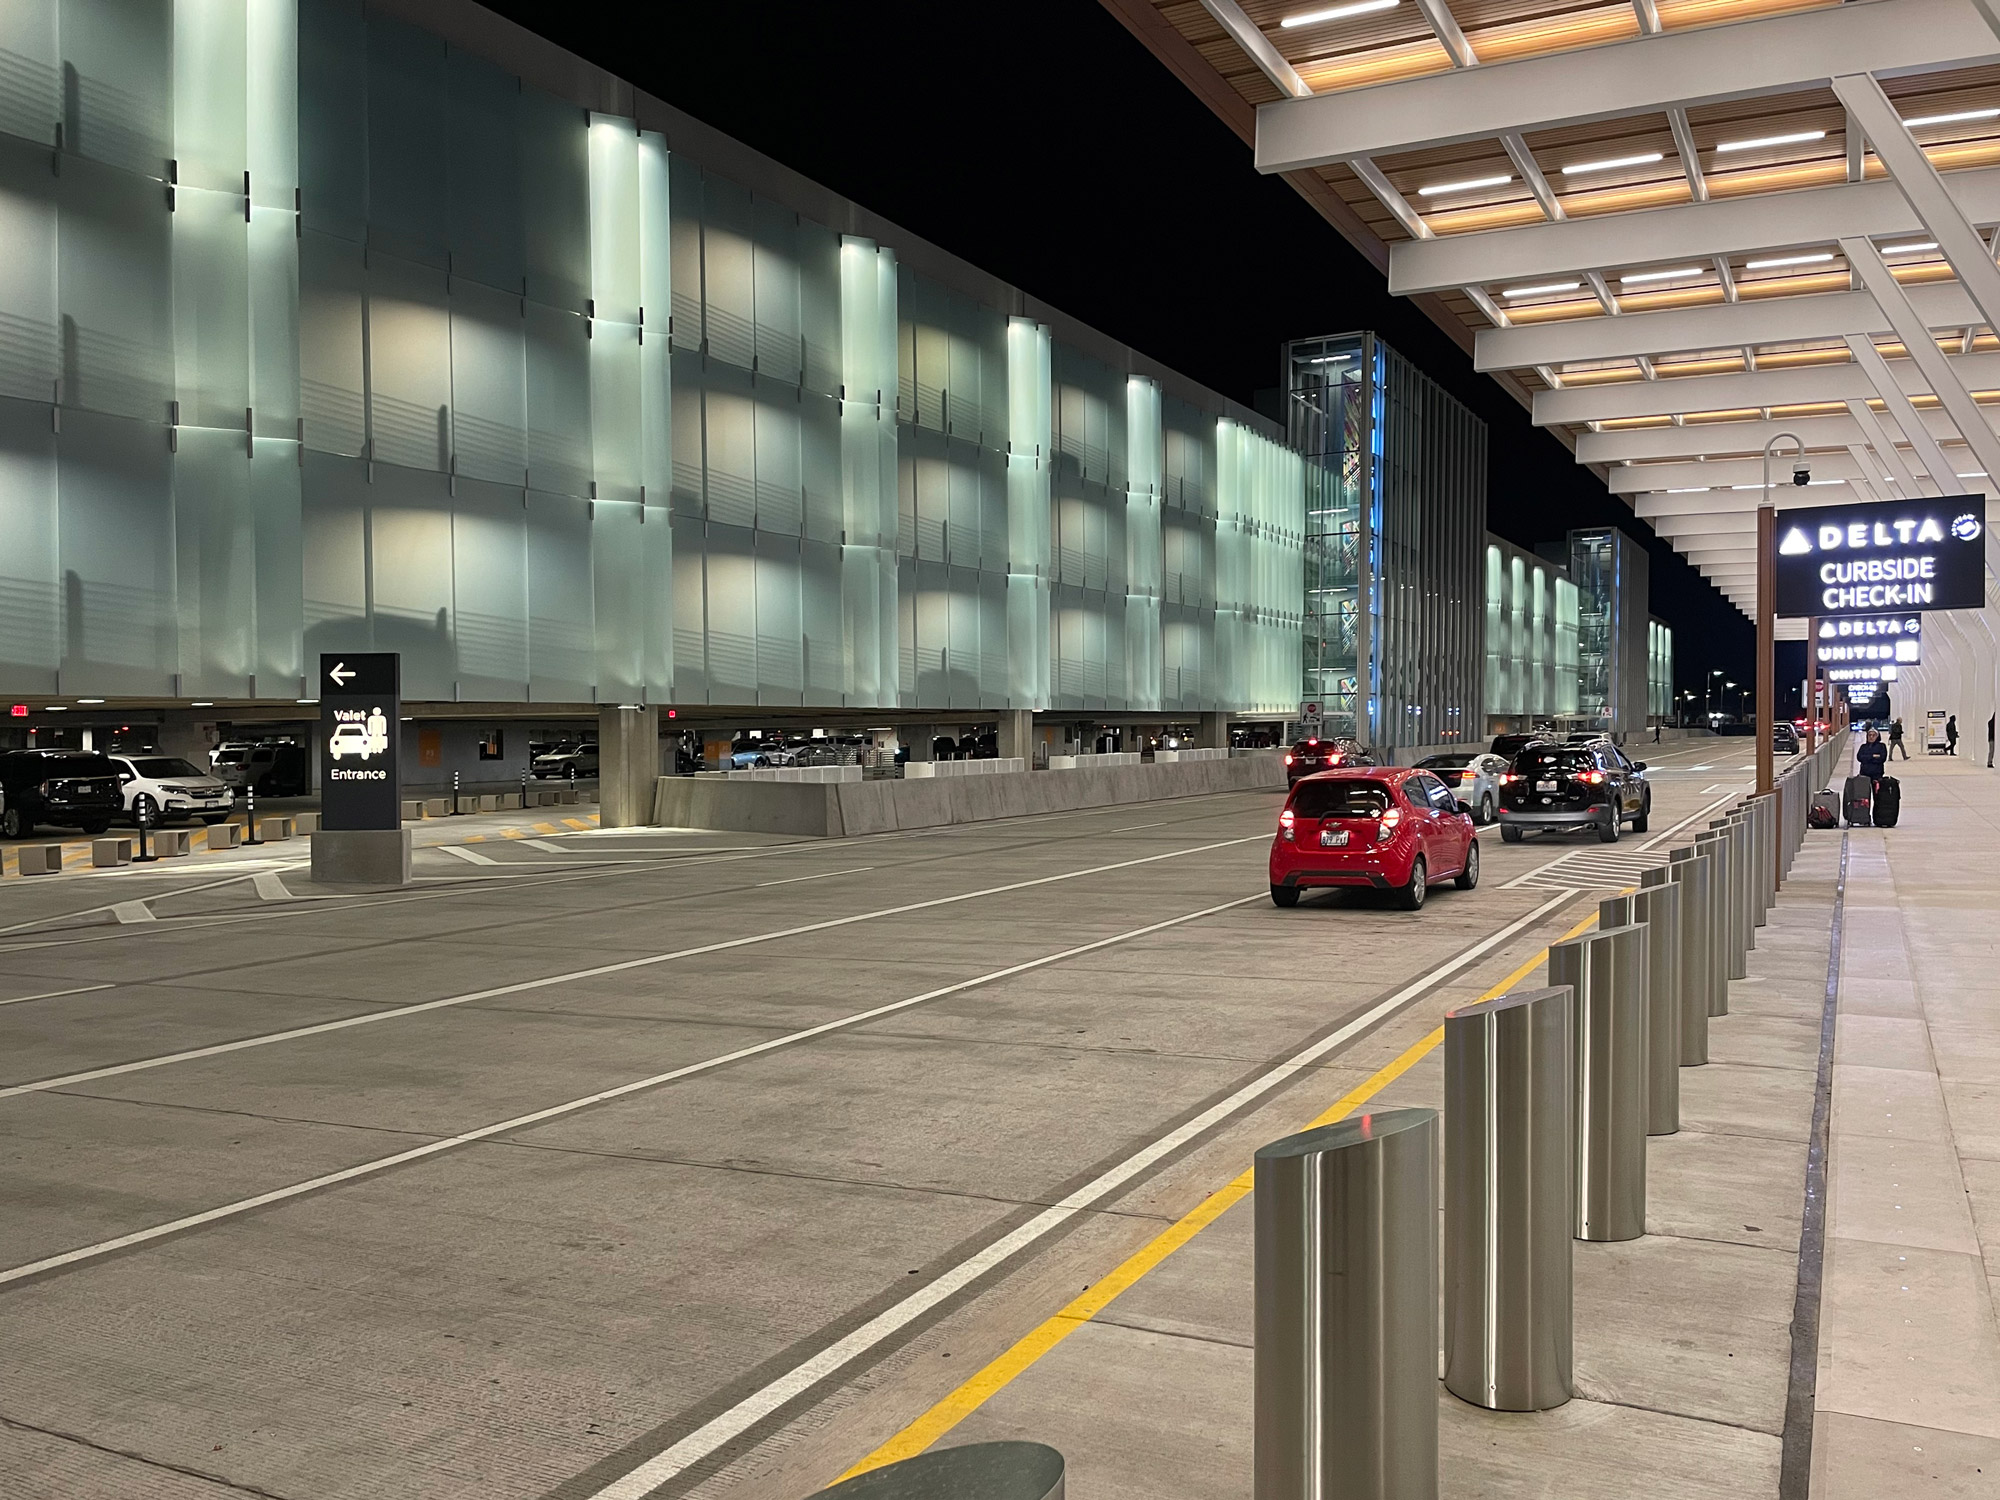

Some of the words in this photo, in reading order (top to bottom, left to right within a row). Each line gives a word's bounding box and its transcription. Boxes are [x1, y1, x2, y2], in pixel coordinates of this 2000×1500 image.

[1819, 520, 1942, 549] DELTA
[1820, 557, 1935, 584] CURBSIDE
[1822, 583, 1933, 609] CHECK-IN
[1839, 620, 1901, 636] DELTA
[1818, 646, 1893, 661] UNITED
[334, 710, 366, 721] Valet
[331, 769, 386, 780] Entrance
